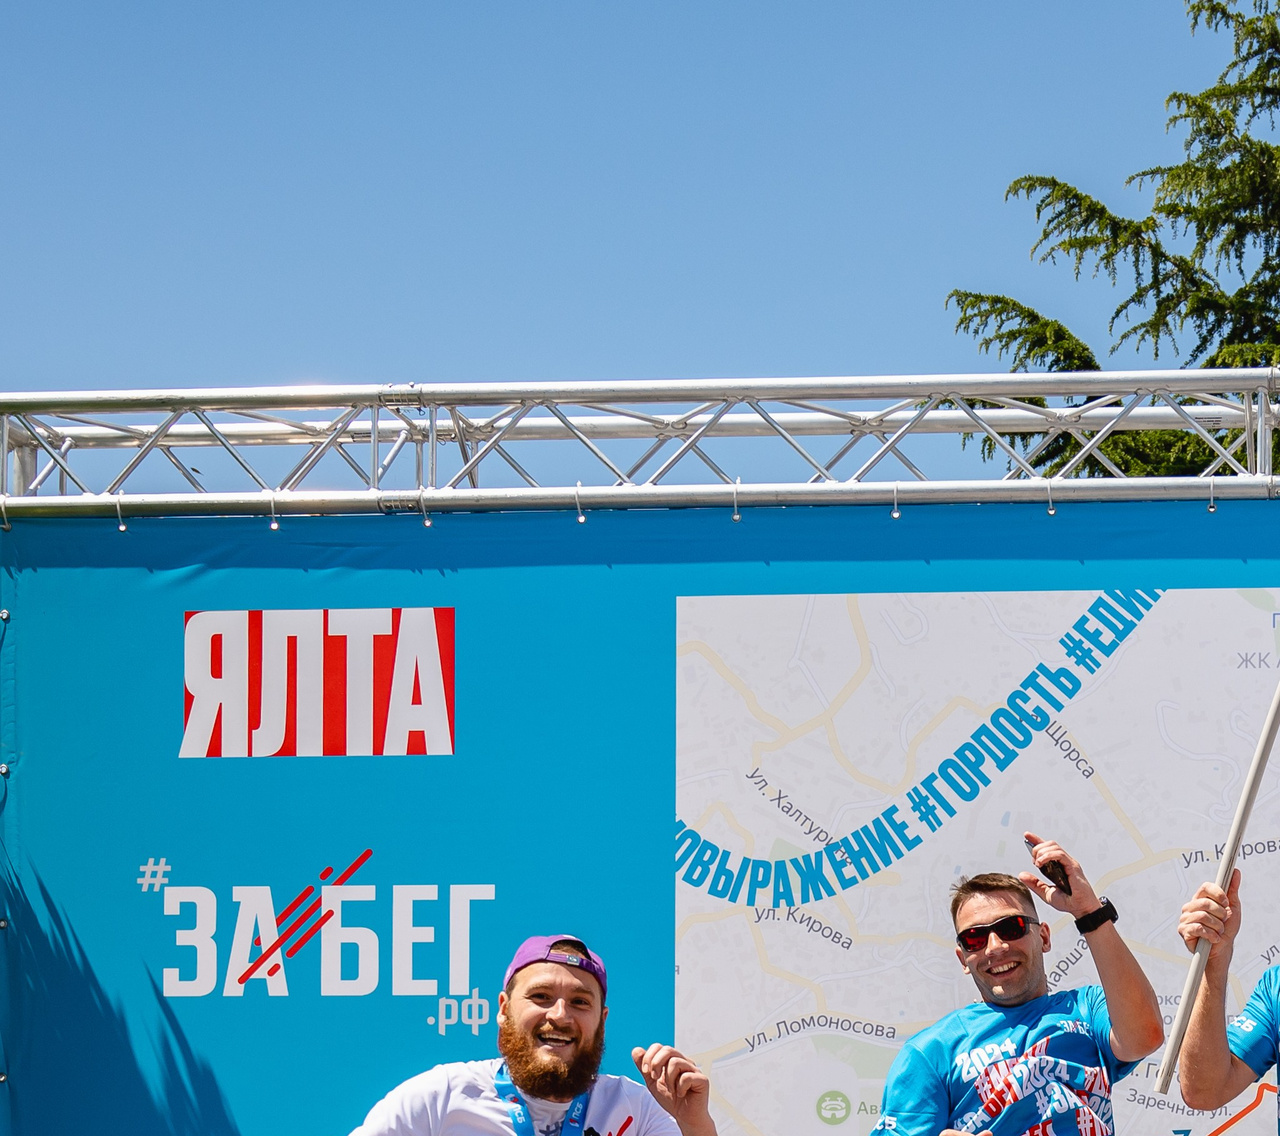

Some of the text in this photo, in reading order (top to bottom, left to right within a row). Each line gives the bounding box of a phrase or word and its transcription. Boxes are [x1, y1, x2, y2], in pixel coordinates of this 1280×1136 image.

[178, 607, 455, 758] ЯЛТА
[1237, 652, 1271, 669] ЖК
[907, 663, 1082, 833] #ГОРДОСТЬ
[1045, 720, 1095, 779] Щорса
[745, 767, 768, 797] ул.
[675, 804, 924, 909] ОВЫРАЖЕНИЕ
[1181, 850, 1210, 869] ул.
[137, 849, 496, 997] #ЗАБЕГ
[754, 906, 854, 951] ул. Кирова
[426, 988, 490, 1036] .рф
[744, 1012, 898, 1052] ул. Ломоносова
